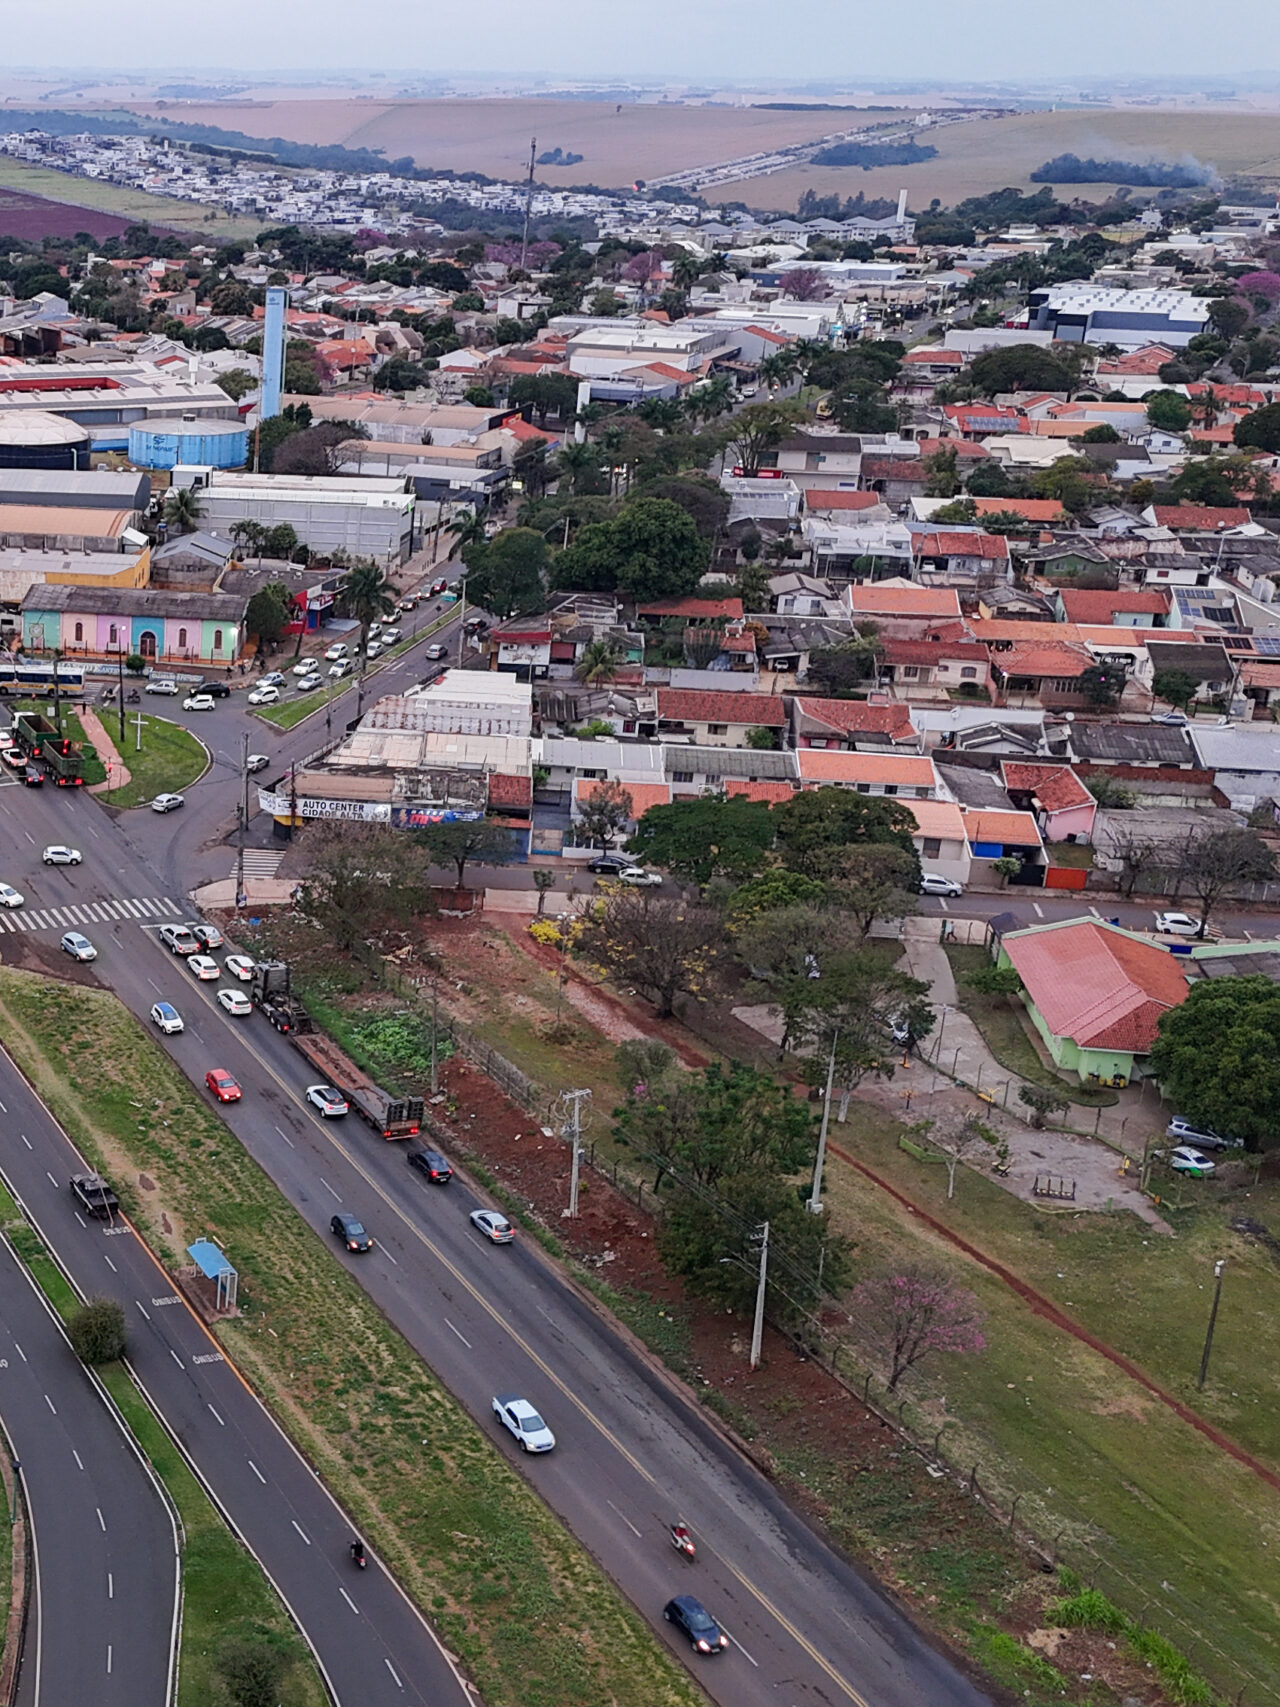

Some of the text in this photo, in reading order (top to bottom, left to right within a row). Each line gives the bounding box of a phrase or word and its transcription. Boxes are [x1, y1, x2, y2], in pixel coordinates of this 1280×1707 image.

[303, 801, 365, 812] AUTO CENTER
[302, 808, 336, 817] CIDADE
[192, 1353, 224, 1364] ÔNIBUS
